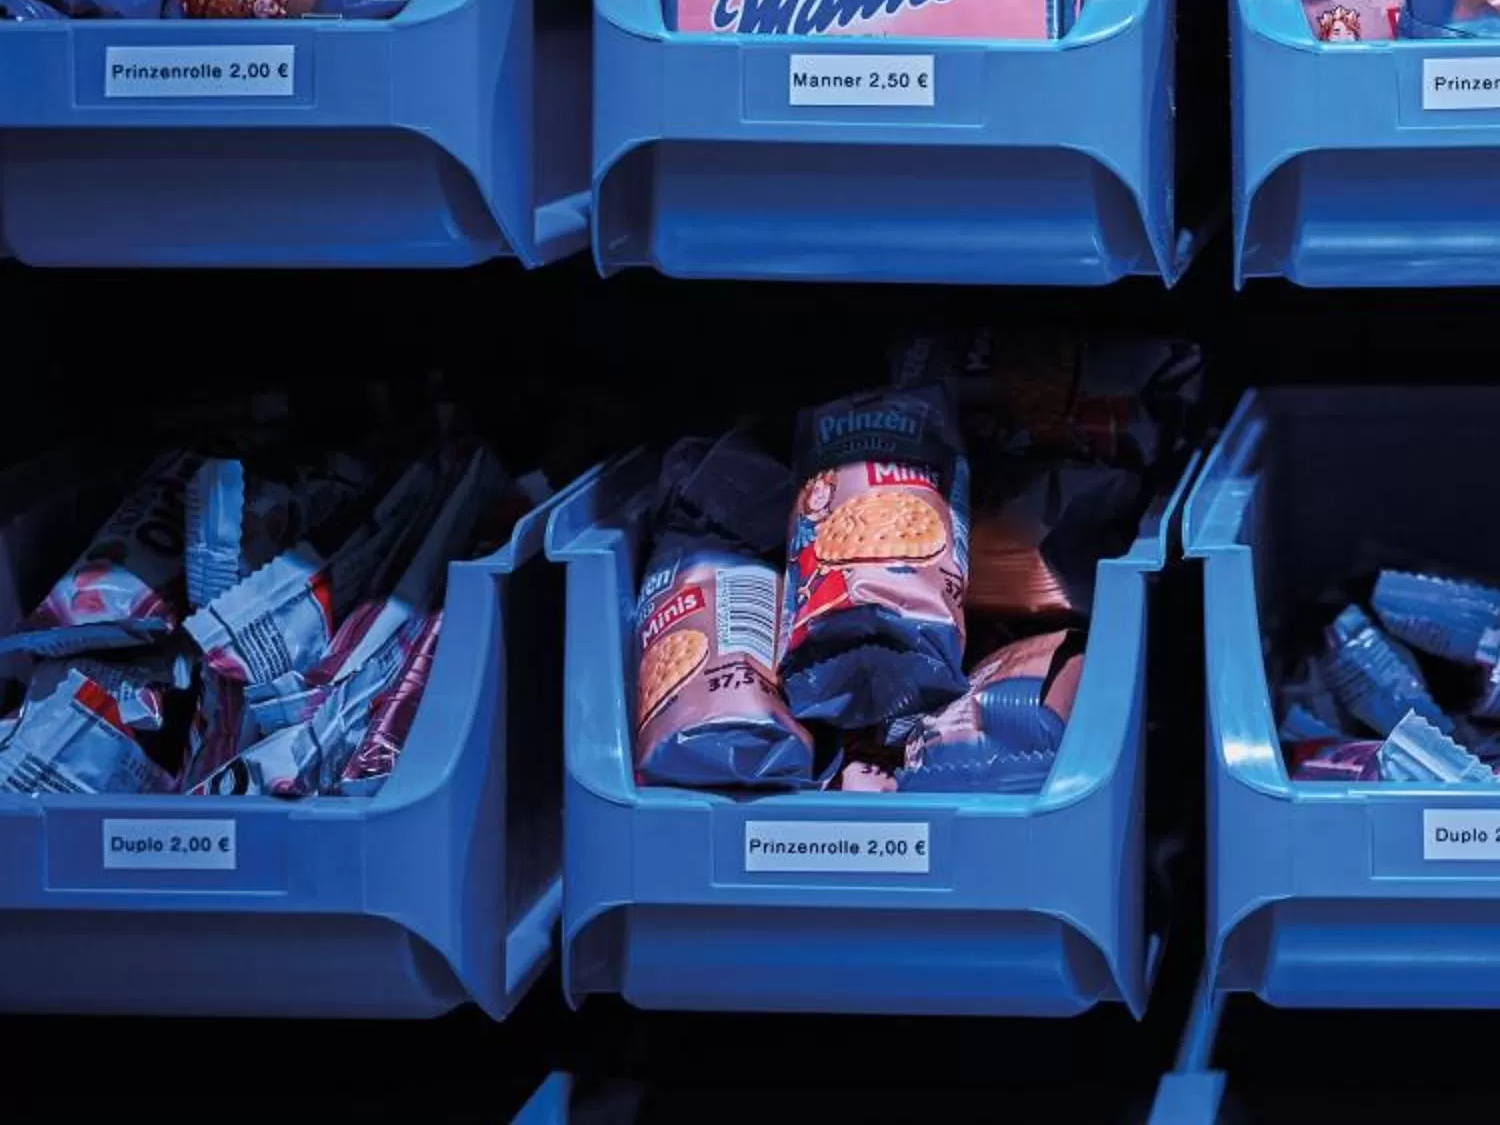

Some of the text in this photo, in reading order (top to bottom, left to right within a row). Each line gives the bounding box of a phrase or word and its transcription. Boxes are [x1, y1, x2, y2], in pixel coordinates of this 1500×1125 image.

[111, 62, 289, 80] Prinzenrolle 2,00 €
[793, 72, 929, 89] Manner 2,50 €
[642, 592, 698, 648] Minis
[1435, 827, 1488, 844] Duplo
[110, 836, 231, 853] Duplo 2,00 €
[749, 838, 926, 856] Prinzenrolle 2,00 €
